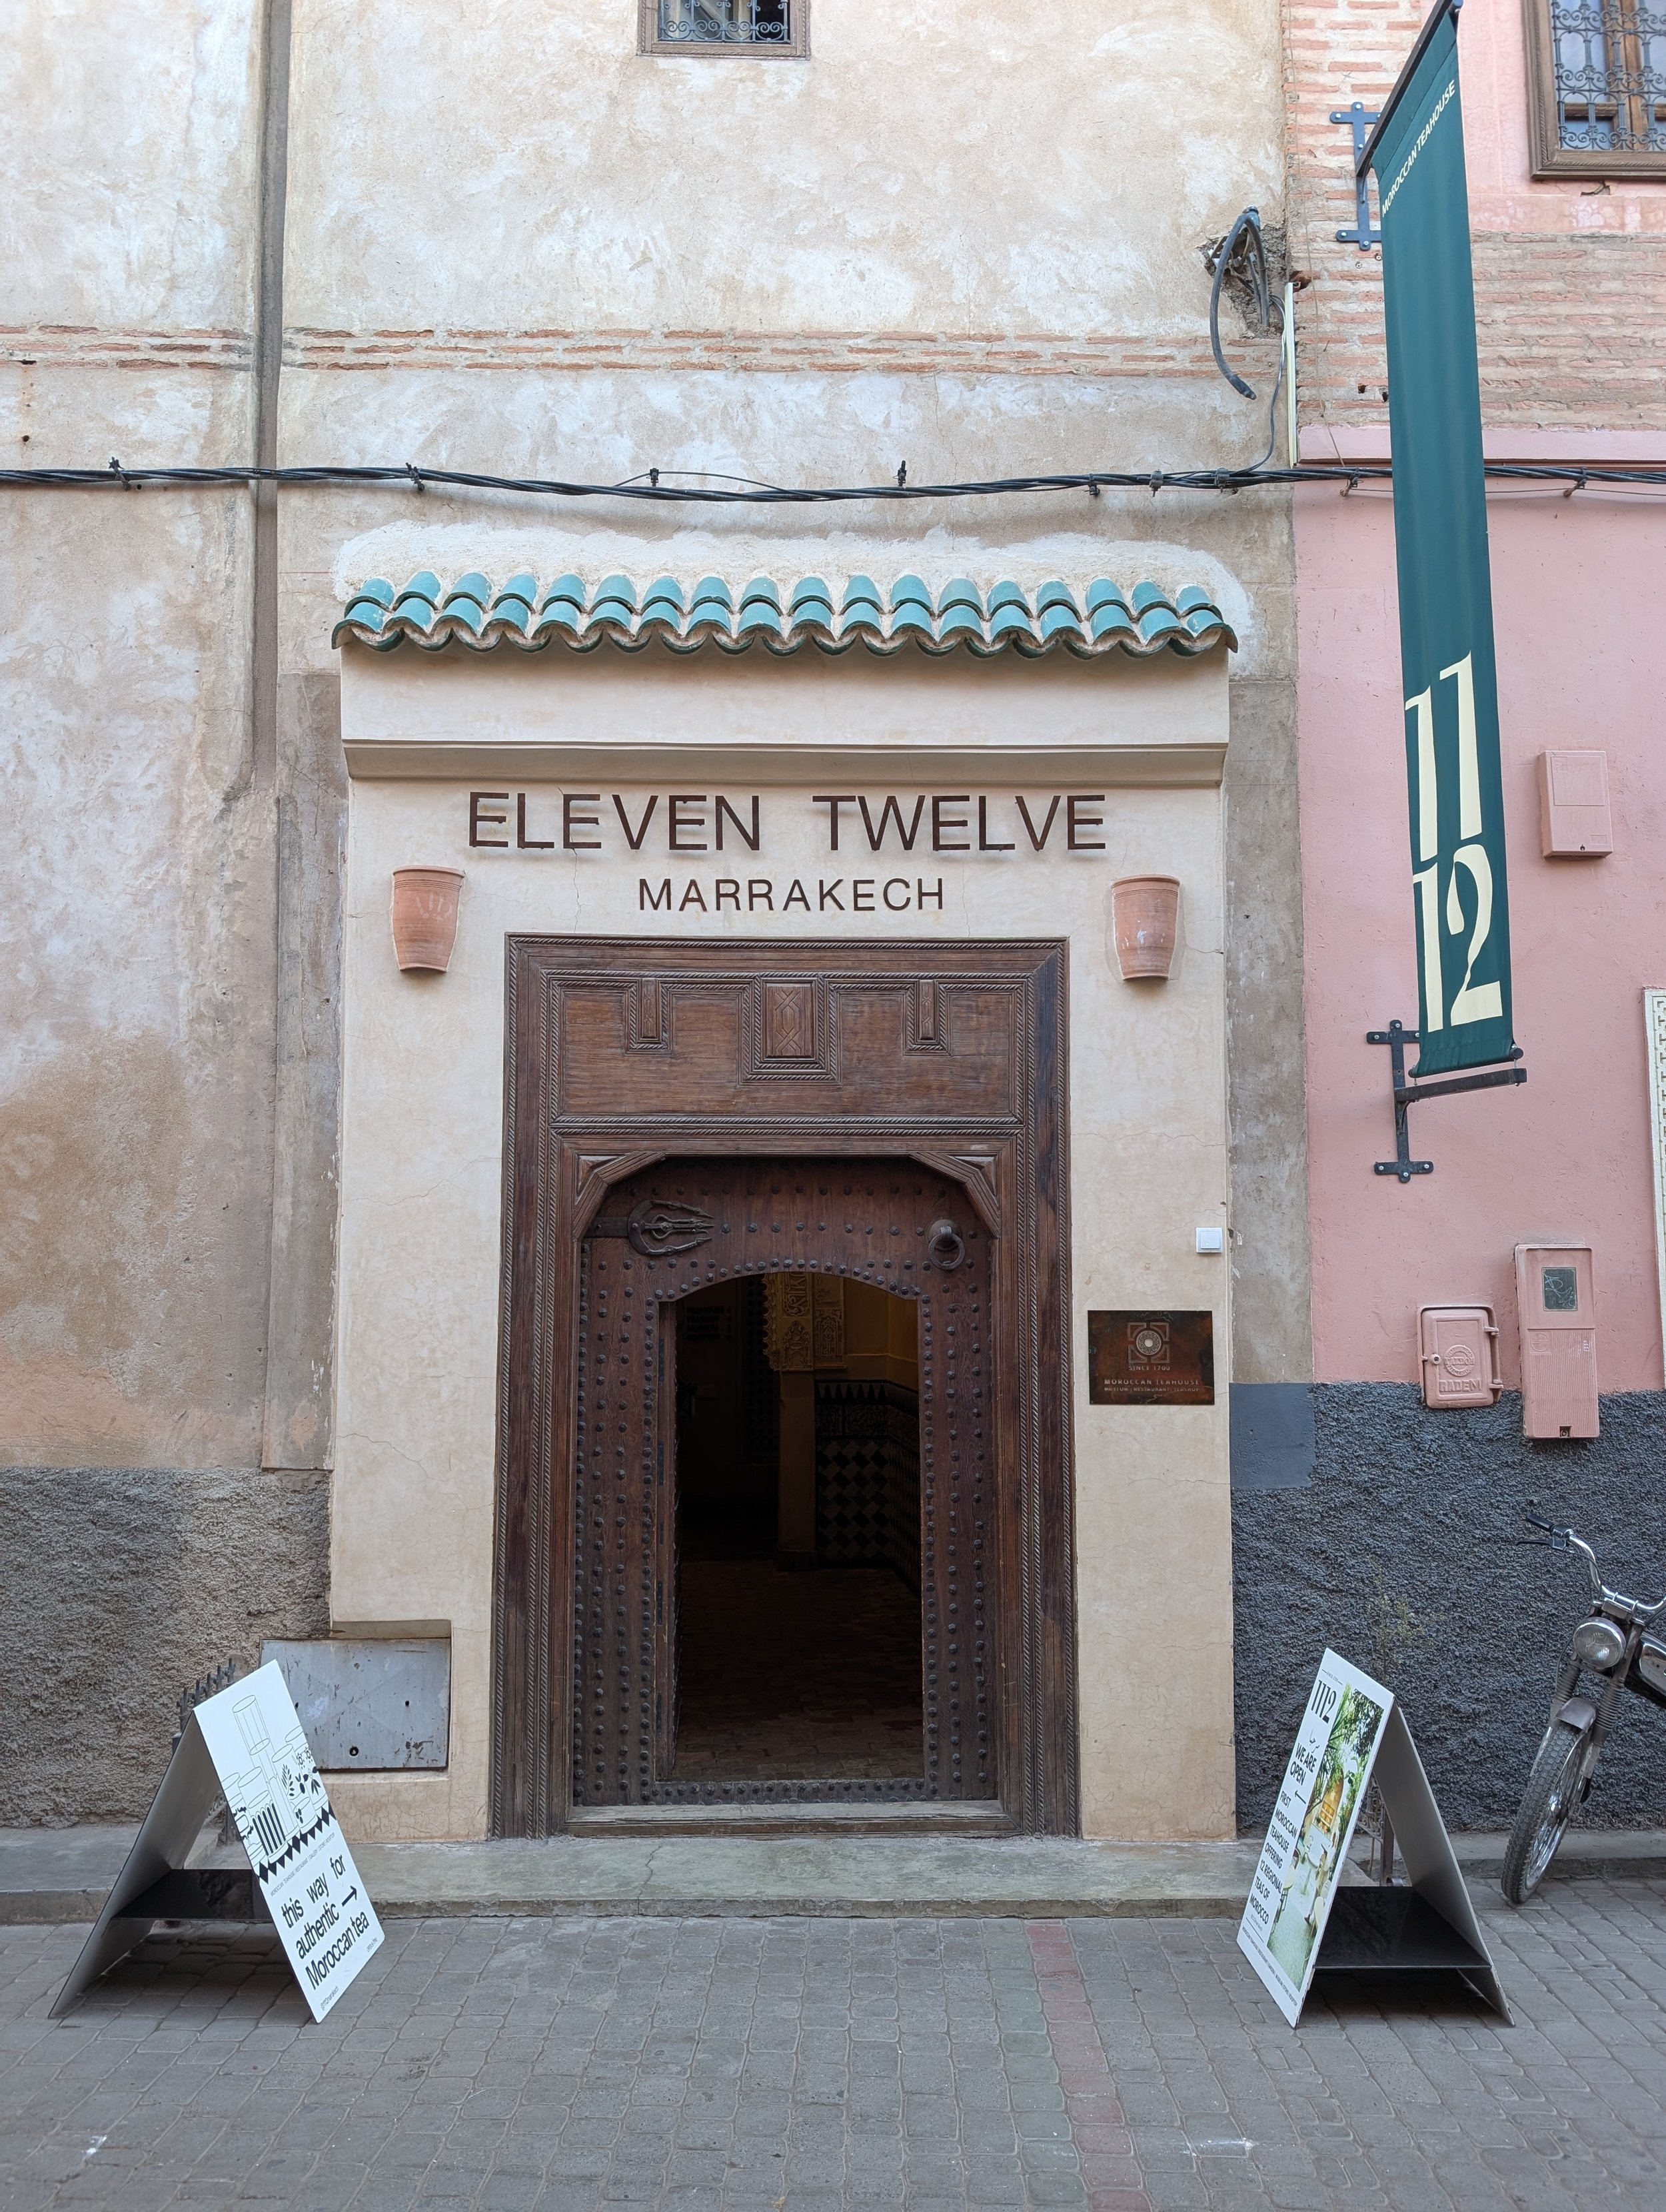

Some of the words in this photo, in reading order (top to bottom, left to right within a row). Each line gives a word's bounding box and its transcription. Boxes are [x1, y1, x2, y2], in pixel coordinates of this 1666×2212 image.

[1382, 146, 1417, 217] MOROCCAN
[1416, 80, 1455, 152] TEAHOUSE
[1405, 650, 1482, 862] 11
[468, 791, 760, 851] ELEVEN
[812, 794, 1107, 851] TWELVE
[638, 877, 944, 912] MARRAKECH
[1412, 843, 1503, 1033] 12
[1311, 1679, 1337, 1724] 1112
[1289, 1760, 1306, 1786] OPEN
[1295, 1742, 1306, 1763] WE
[1303, 1752, 1317, 1774] ARE
[1280, 1790, 1291, 1808] FIRST
[1269, 1824, 1289, 1854] TEAHOUSE
[1274, 1807, 1297, 1840] MOROCCAN
[1265, 1842, 1283, 1870] OFFERING
[281, 1898, 304, 1928] this
[307, 1873, 329, 1904] way
[330, 1854, 346, 1879] for
[1254, 1876, 1264, 1895] TEAS
[1263, 1888, 1270, 1901] OF
[1259, 1858, 1265, 1872] 12
[1263, 1864, 1283, 1895] REGIONAL
[1250, 1893, 1269, 1925] MOROCCO
[296, 1902, 339, 1959] authentic
[305, 1926, 356, 1990] Moroccan
[350, 1911, 370, 1938] tea
